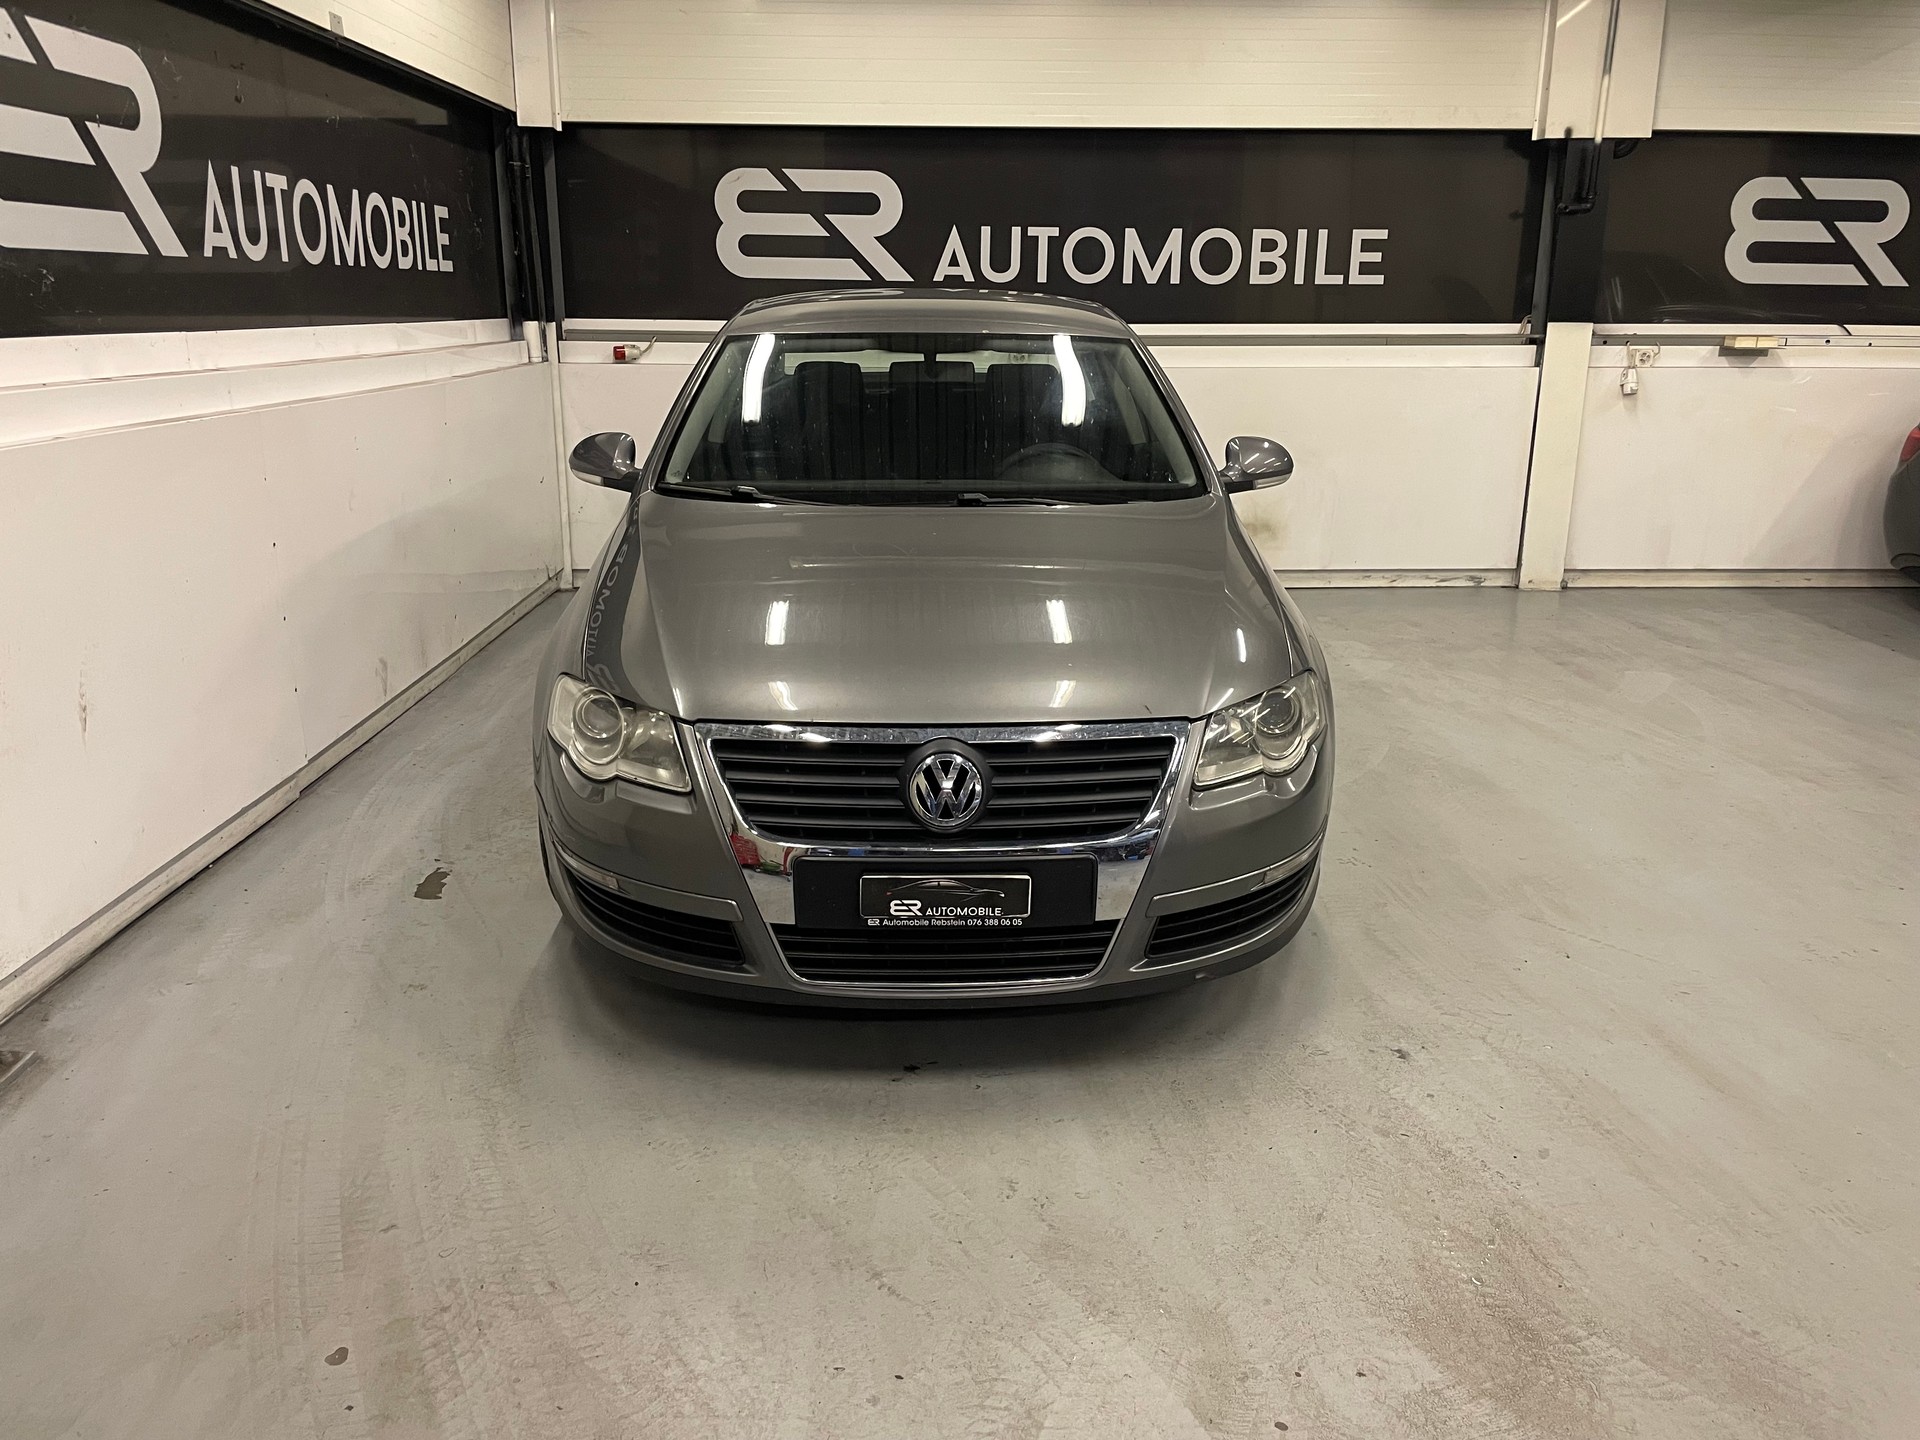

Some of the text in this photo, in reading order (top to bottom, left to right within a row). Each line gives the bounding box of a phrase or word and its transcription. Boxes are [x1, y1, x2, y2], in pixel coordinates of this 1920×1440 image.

[203, 159, 454, 272] AUTOMOBILE
[714, 167, 1389, 285] ER AUTOMOBILE
[1724, 176, 1911, 287] ER
[911, 754, 981, 826] VW
[882, 917, 930, 926] Automobile
[931, 918, 966, 926] Rebstein
[967, 918, 983, 926] 076
[984, 918, 999, 926] 388
[1000, 918, 1012, 926] 06
[1012, 918, 1023, 926] 05
[889, 900, 1002, 916] ER AUTOMOBILE
